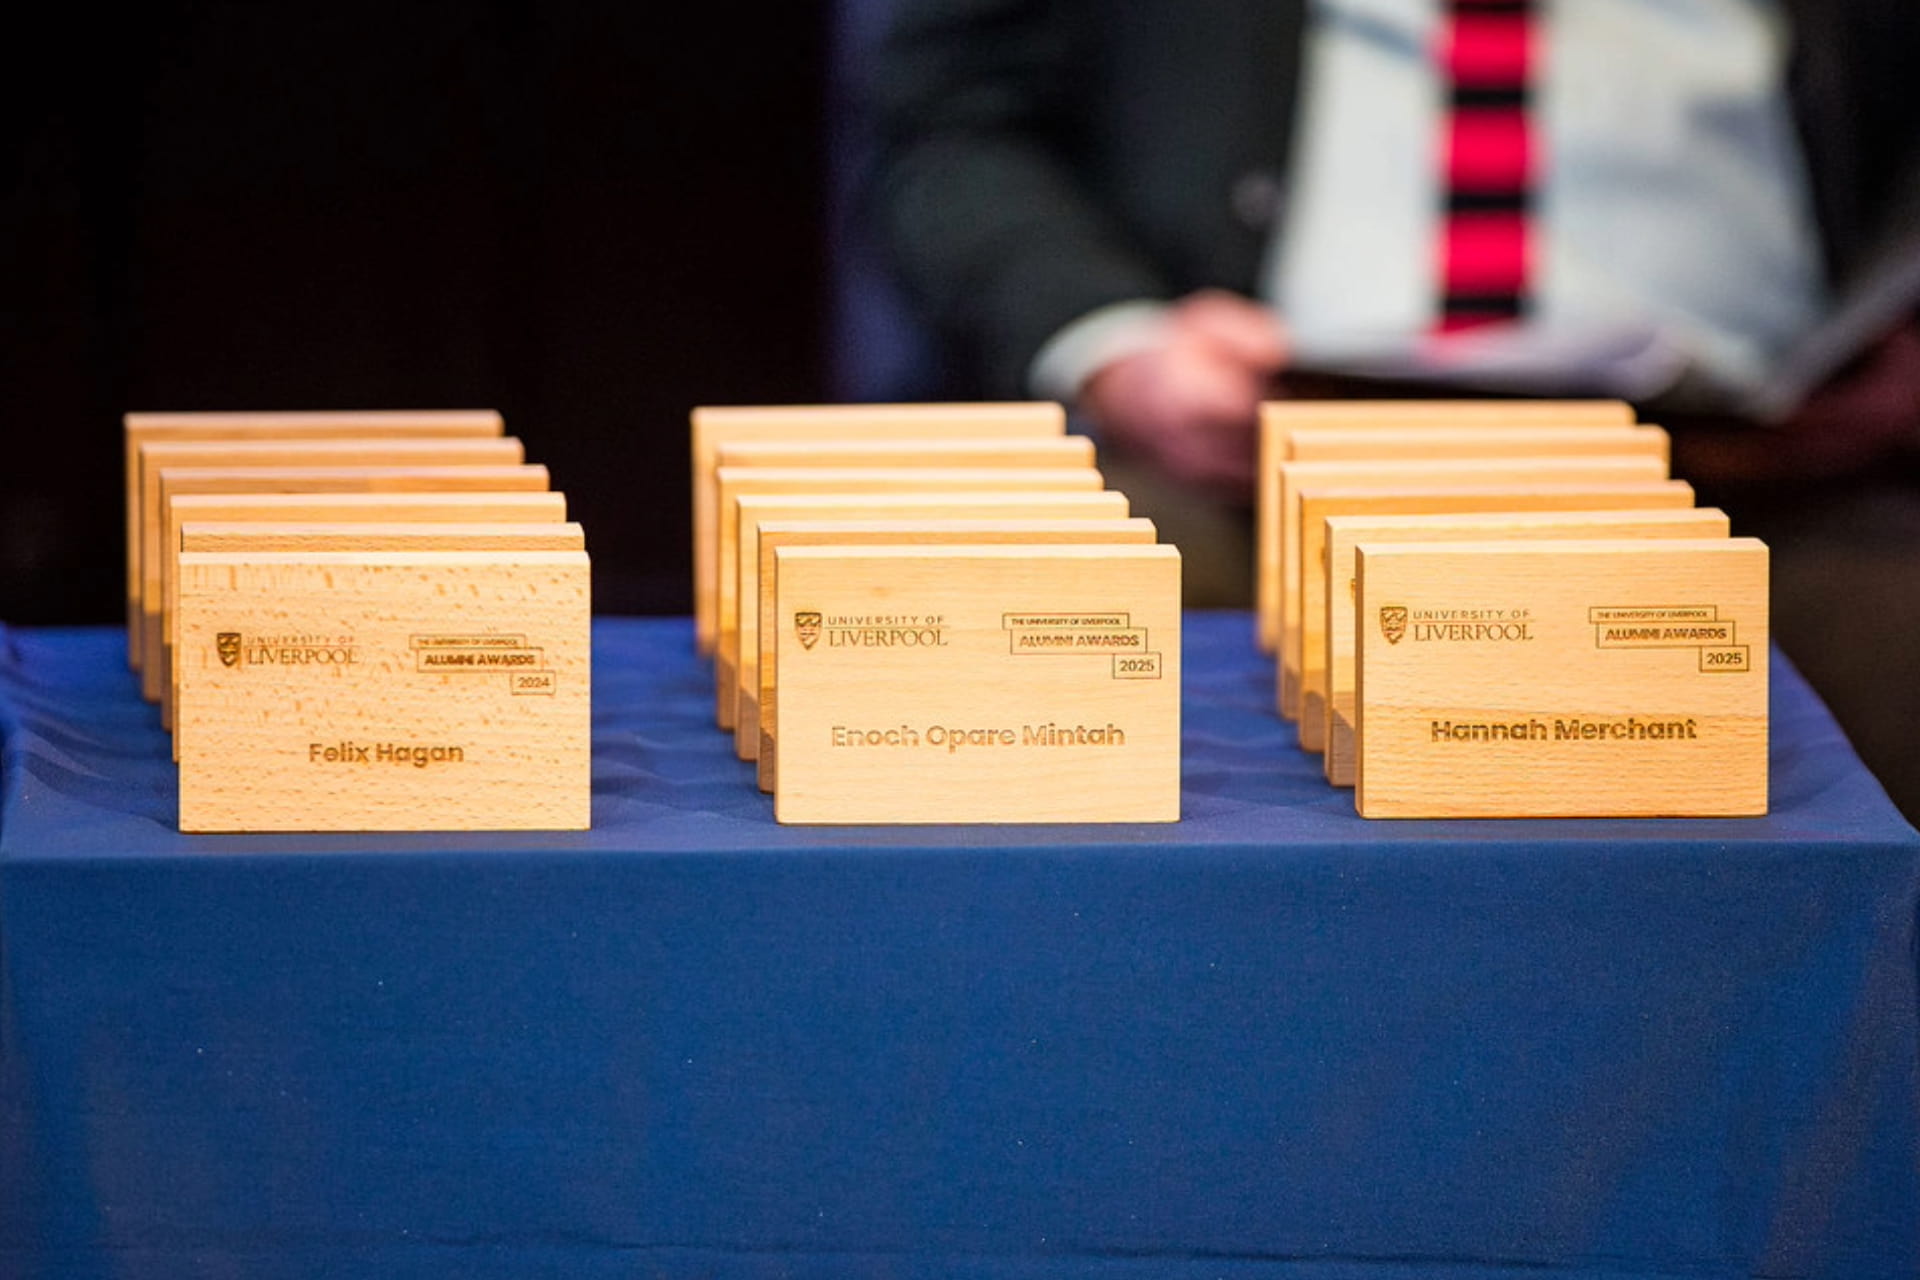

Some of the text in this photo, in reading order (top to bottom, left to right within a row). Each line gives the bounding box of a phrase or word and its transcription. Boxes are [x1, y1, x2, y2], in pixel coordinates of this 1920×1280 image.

[828, 616, 944, 625] UNIVERSITY OF
[1413, 609, 1530, 619] UNIVERSITY OF
[829, 630, 948, 647] LIVERPOOL
[1414, 624, 1533, 642] LIVERPOOL
[1605, 628, 1727, 641] ALUMNI AWARDS
[247, 636, 330, 645] UNIVERSITY
[1020, 634, 1140, 647] ALUMNI AWARDS
[249, 648, 360, 665] LIVERPOOL
[477, 654, 535, 666] AWARDS
[1707, 652, 1743, 665] 2025
[1120, 659, 1155, 672] 2025
[518, 677, 551, 688] 2024
[1431, 718, 1697, 742] Hannah Merchant
[831, 722, 1125, 753] Enoch Opare Mintah
[309, 741, 465, 769] Felix Hagan
